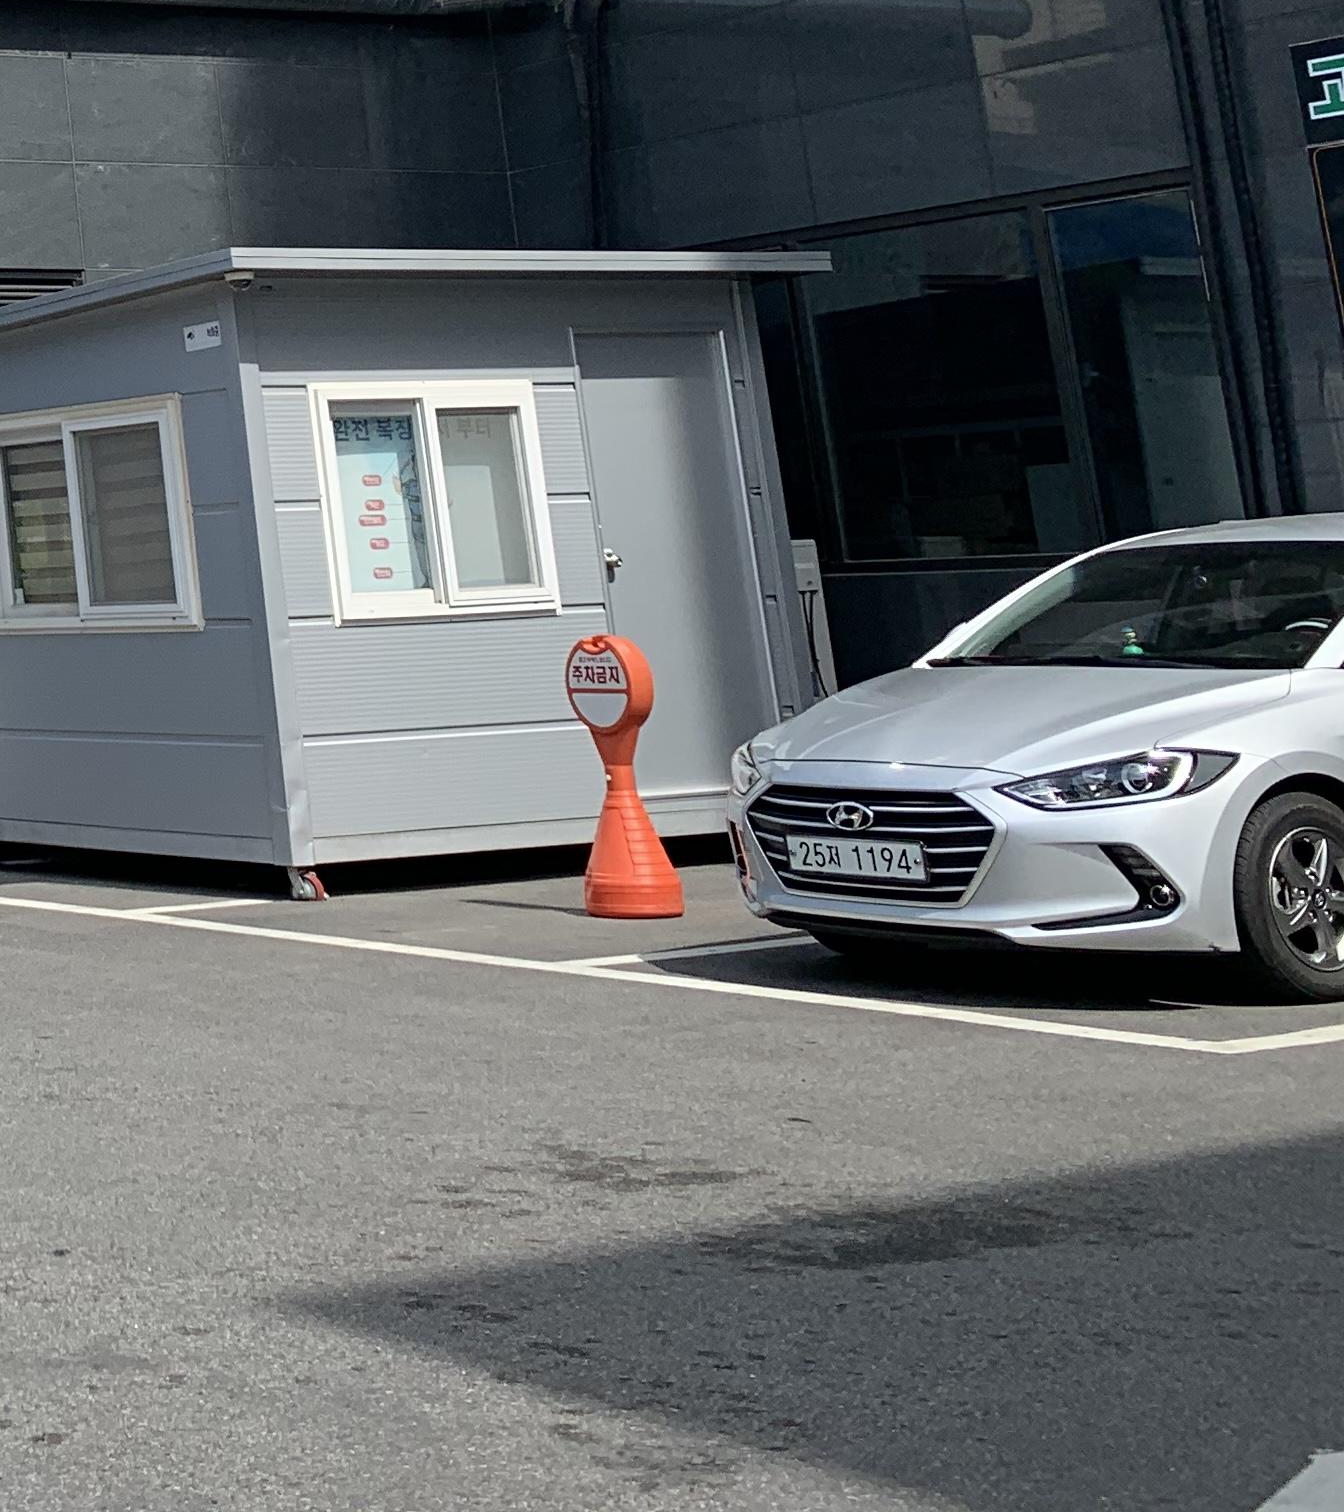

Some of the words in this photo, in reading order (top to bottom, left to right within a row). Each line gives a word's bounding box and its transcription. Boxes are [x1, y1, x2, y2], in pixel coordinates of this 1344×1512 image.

[572, 665, 620, 684] 주차금지
[799, 841, 841, 868] 25저
[852, 845, 913, 874] 1194
